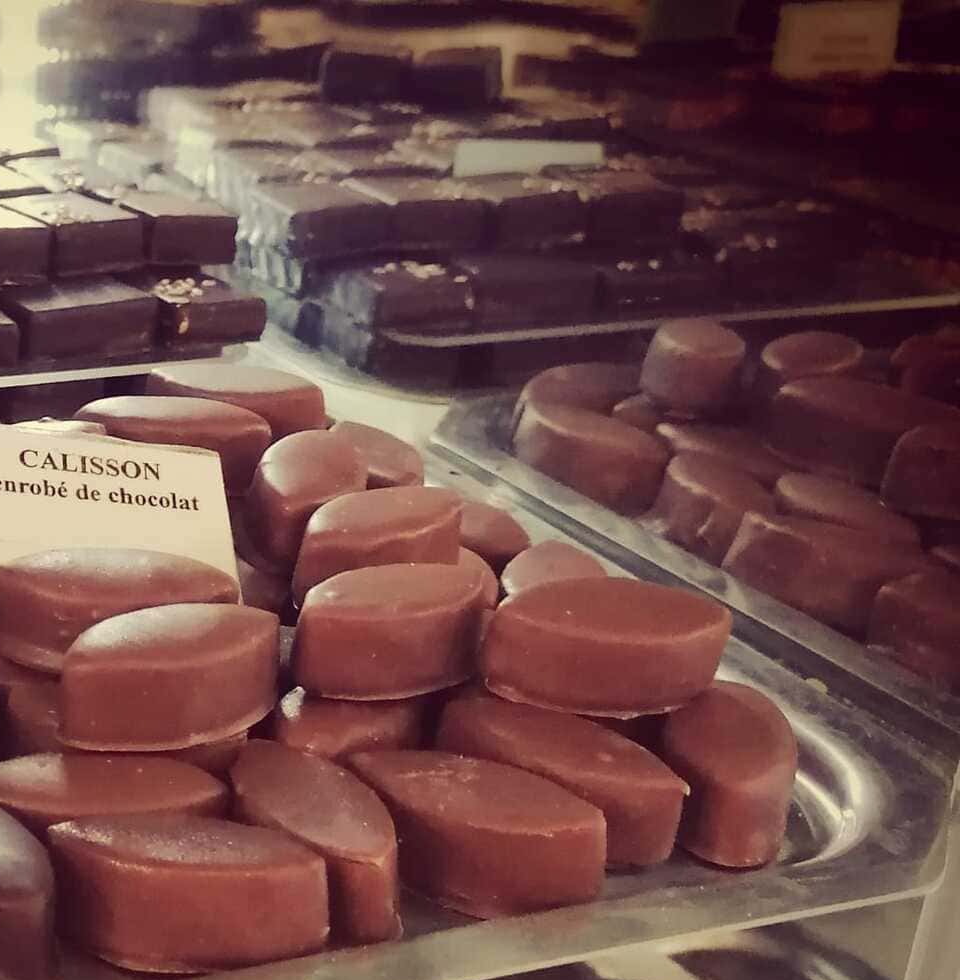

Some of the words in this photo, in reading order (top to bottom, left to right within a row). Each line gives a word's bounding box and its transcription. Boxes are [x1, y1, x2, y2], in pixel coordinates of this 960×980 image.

[19, 449, 161, 481] CALISSON
[76, 484, 101, 502] de
[108, 488, 200, 511] chocolat
